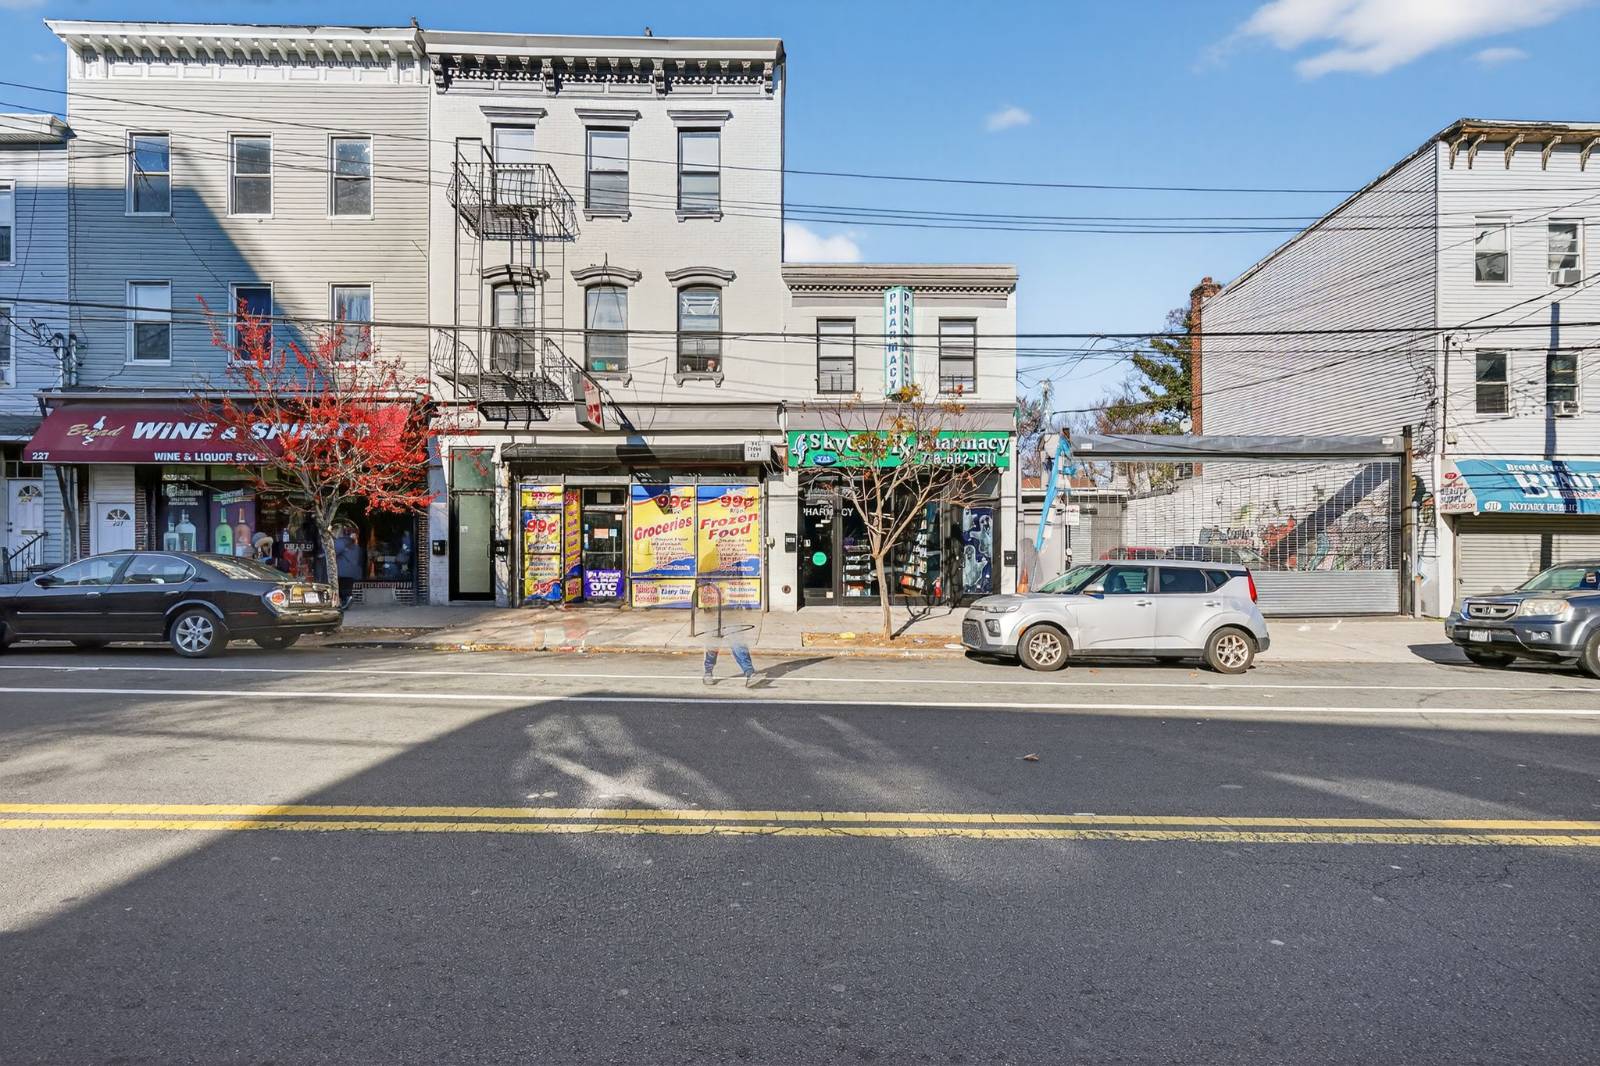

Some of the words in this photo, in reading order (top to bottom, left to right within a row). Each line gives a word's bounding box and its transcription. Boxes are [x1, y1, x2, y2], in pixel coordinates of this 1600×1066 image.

[889, 292, 898, 389] PHARMACY
[132, 422, 218, 440] WINE
[220, 427, 238, 440] &
[32, 452, 50, 461] 227
[154, 452, 182, 462] WINE
[183, 453, 192, 461] &
[194, 452, 234, 462] LIQUOR
[1506, 463, 1538, 472] Broad
[1509, 502, 1545, 512] NOTARY
[527, 519, 558, 535] 99¢
[634, 516, 692, 541] Groceries
[700, 513, 758, 530] Frozen
[708, 523, 751, 540] Food
[590, 582, 617, 591] OTC
